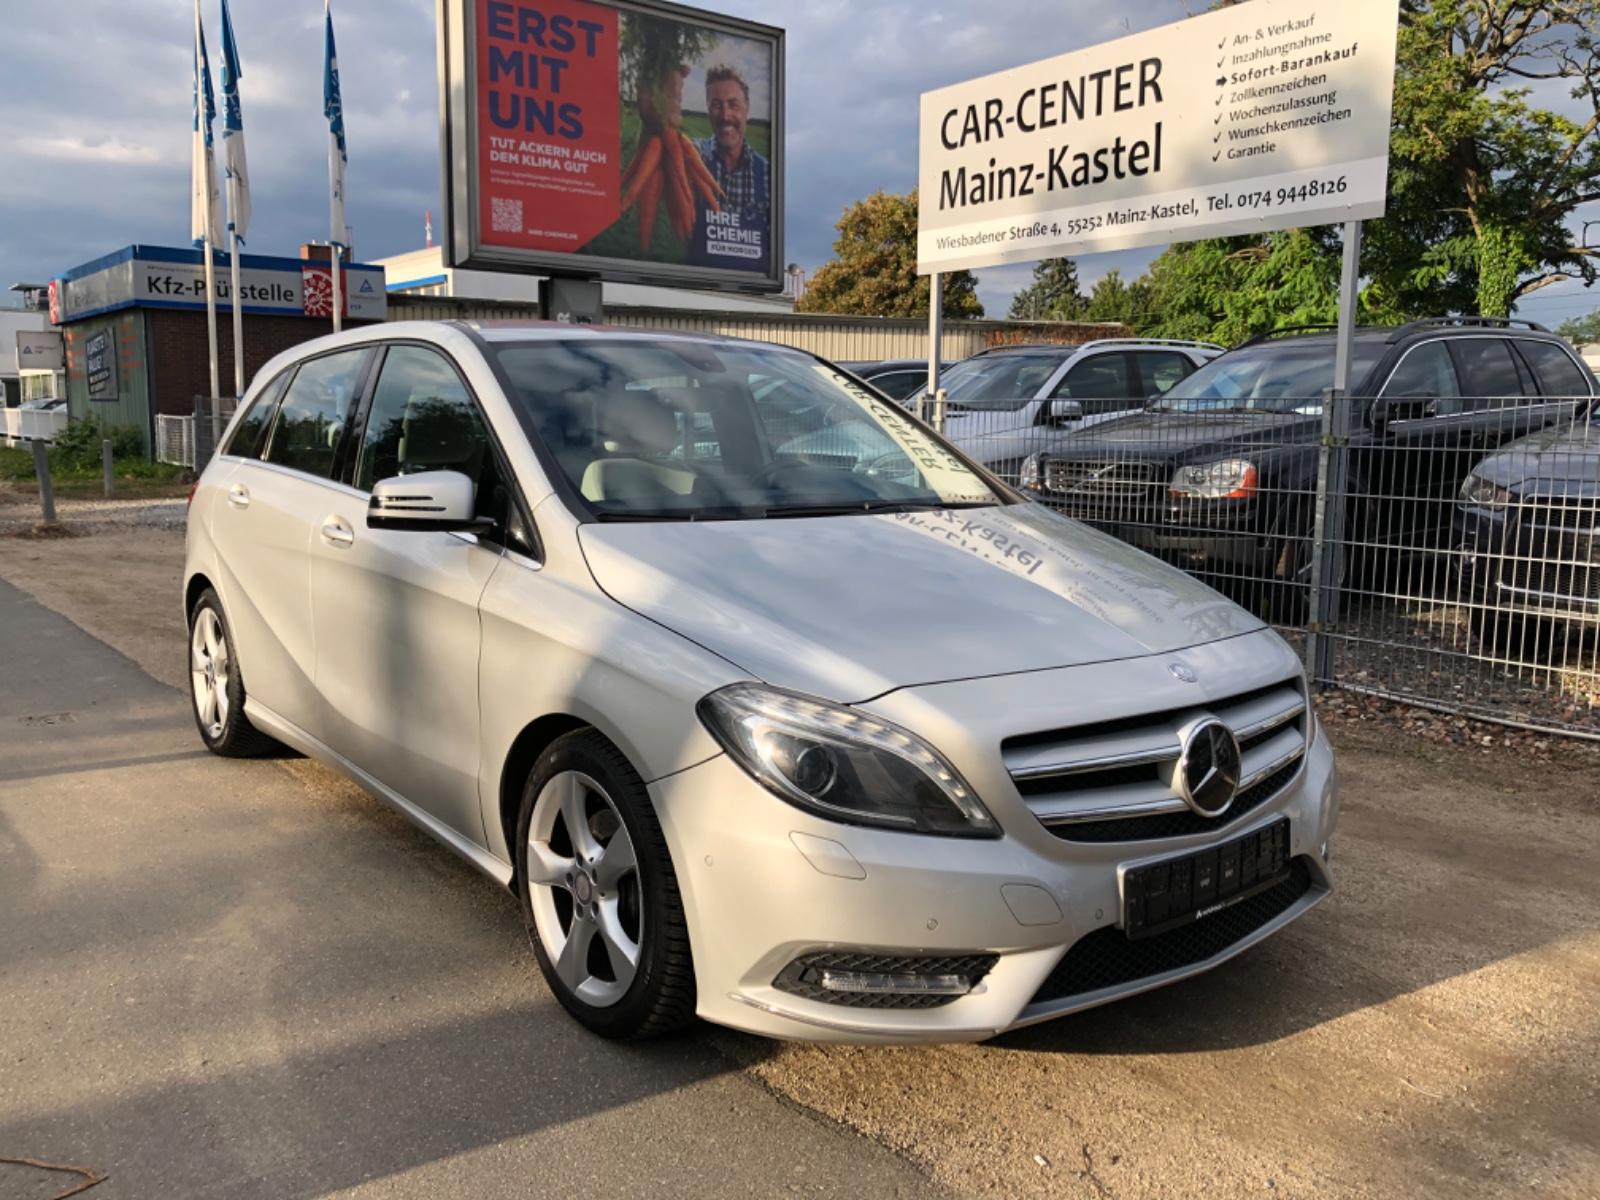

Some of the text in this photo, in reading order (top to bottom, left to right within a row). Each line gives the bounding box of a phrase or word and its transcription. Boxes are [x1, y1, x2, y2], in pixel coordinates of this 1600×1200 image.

[487, 0, 604, 57] ERST
[1232, 12, 1316, 47] An- & Verkauf
[1230, 42, 1359, 85] Sofort-Barankauf
[1231, 32, 1333, 66] Inzahlungnahme
[488, 44, 569, 94] MIT
[940, 56, 1164, 150] CAR-CENTER
[1229, 73, 1327, 104] Zollkennzeichen
[488, 90, 584, 140] UNS
[1229, 90, 1337, 122] Wochenzulassung
[1228, 108, 1352, 141] Wunschkennzeichen
[490, 136, 607, 164] TUT ACKERN AUCH
[490, 150, 589, 174] DEM KLIMA GUT
[938, 121, 1163, 210] Mainz-Kastel
[1227, 141, 1277, 160] Garantie
[705, 209, 740, 227] IHRE
[936, 175, 1347, 250] Wiesbadener Straße 4, 55252 Mainz-Kastel, Tel. 0174 9448126
[706, 225, 761, 244] CHEMIE
[147, 275, 295, 303] Kfz-Püstelle
